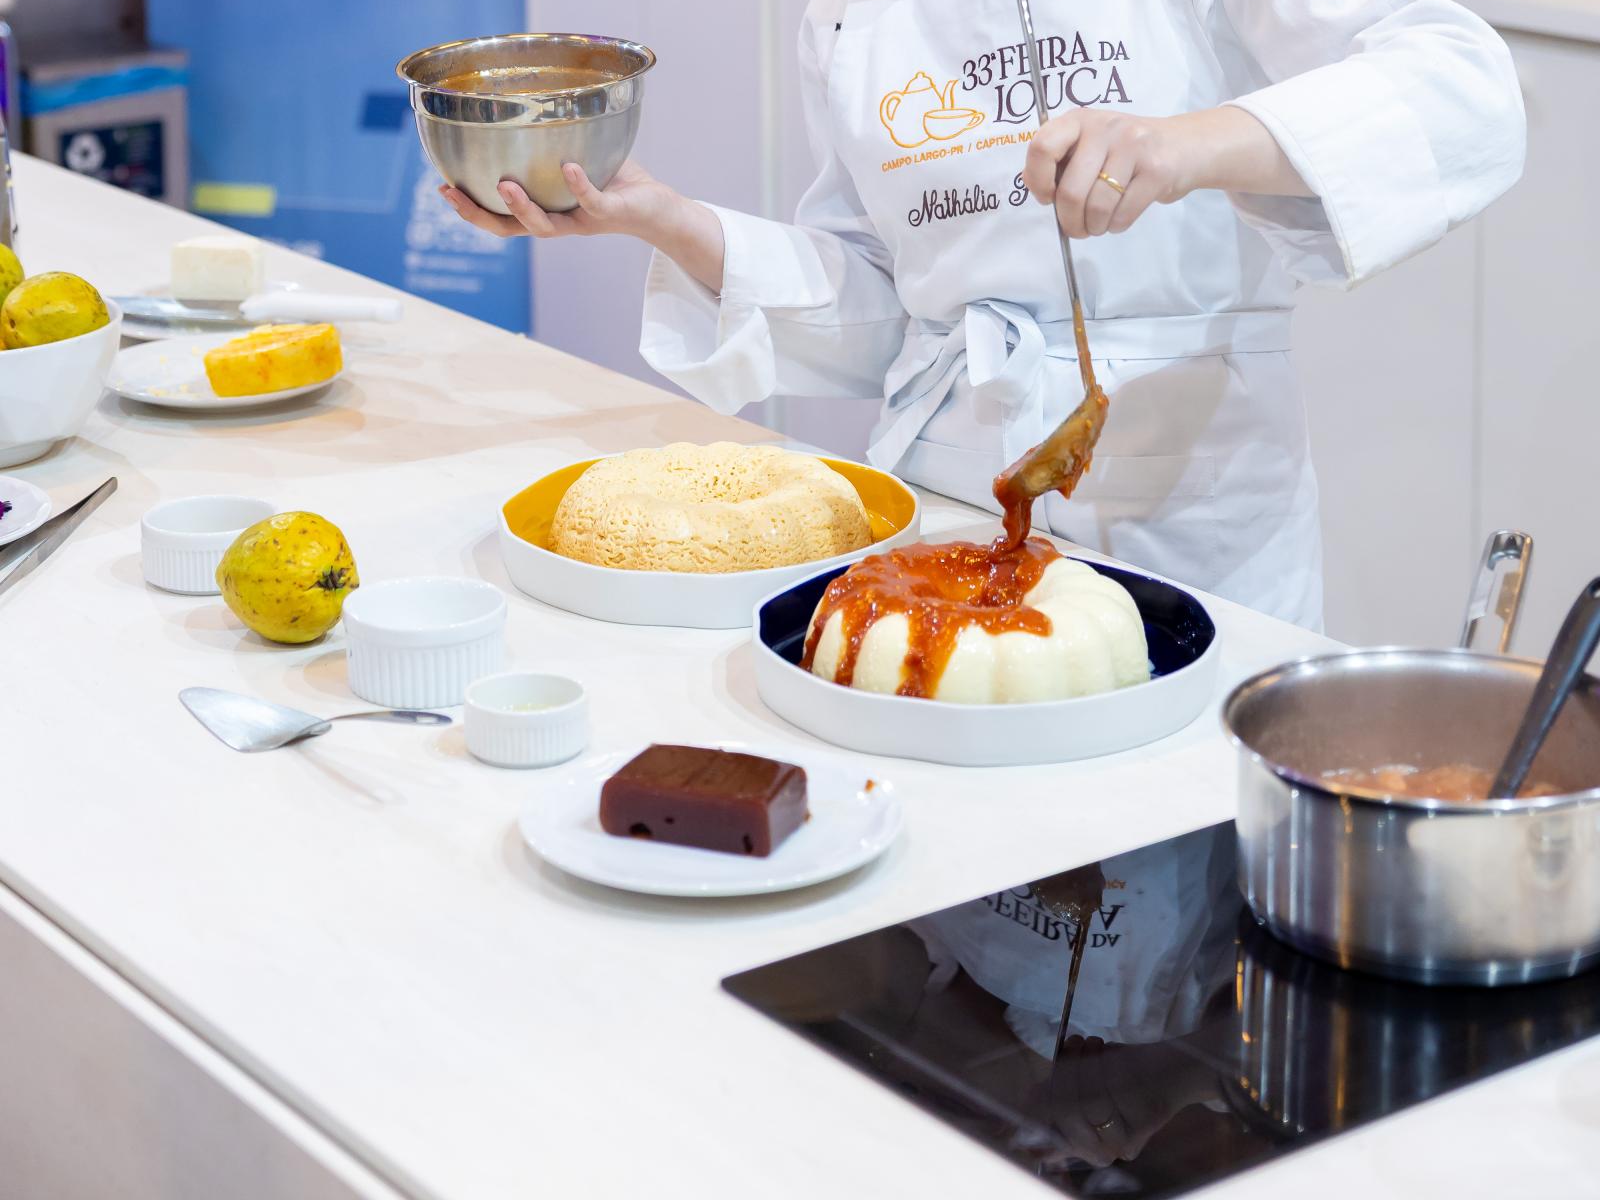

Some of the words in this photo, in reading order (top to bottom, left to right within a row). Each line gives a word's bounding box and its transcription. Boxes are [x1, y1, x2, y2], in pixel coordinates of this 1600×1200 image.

[1098, 40, 1130, 61] DA
[881, 156, 912, 173] CAMPO
[914, 145, 964, 164] LARGO-PR
[976, 133, 1016, 150] CAPITAL
[908, 184, 1000, 227] Nathália
